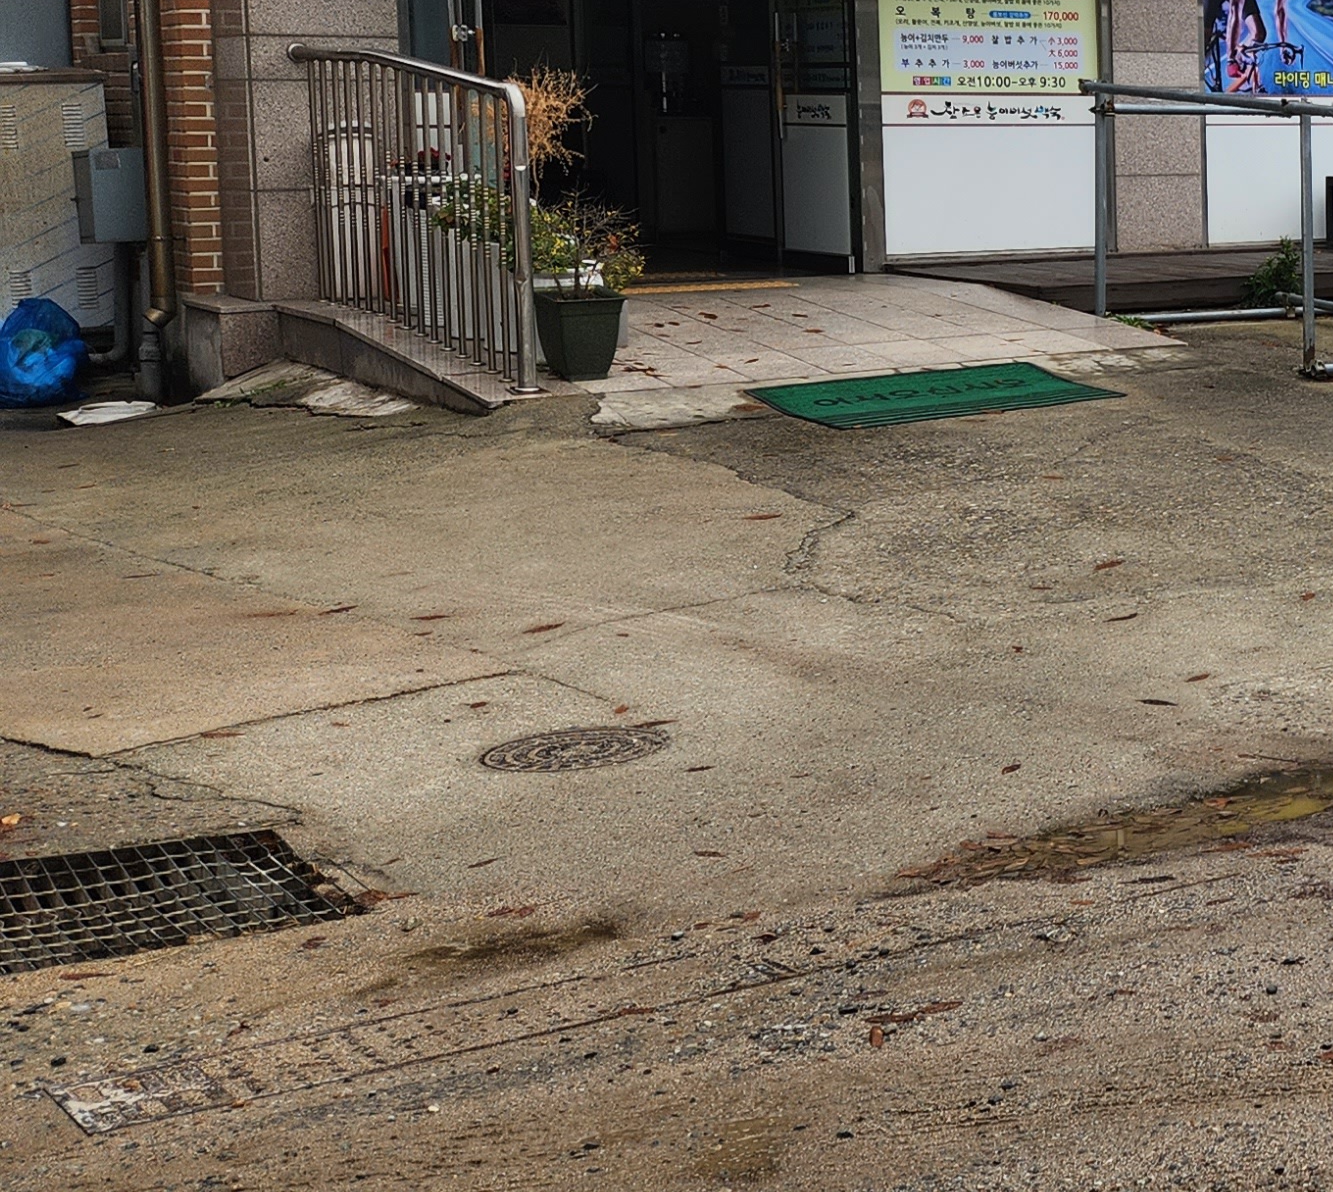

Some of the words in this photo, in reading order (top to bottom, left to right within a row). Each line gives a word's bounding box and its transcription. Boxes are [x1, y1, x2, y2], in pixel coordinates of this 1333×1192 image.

[1043, 11, 1079, 23] 170,000
[962, 35, 984, 45] 9,000
[1057, 37, 1078, 46] 3,000
[1057, 49, 1078, 58] 6,000
[963, 60, 985, 70] 3,000
[1053, 61, 1079, 70] 15,000
[1040, 76, 1066, 88] 9:30
[1274, 72, 1310, 88] 라이딩
